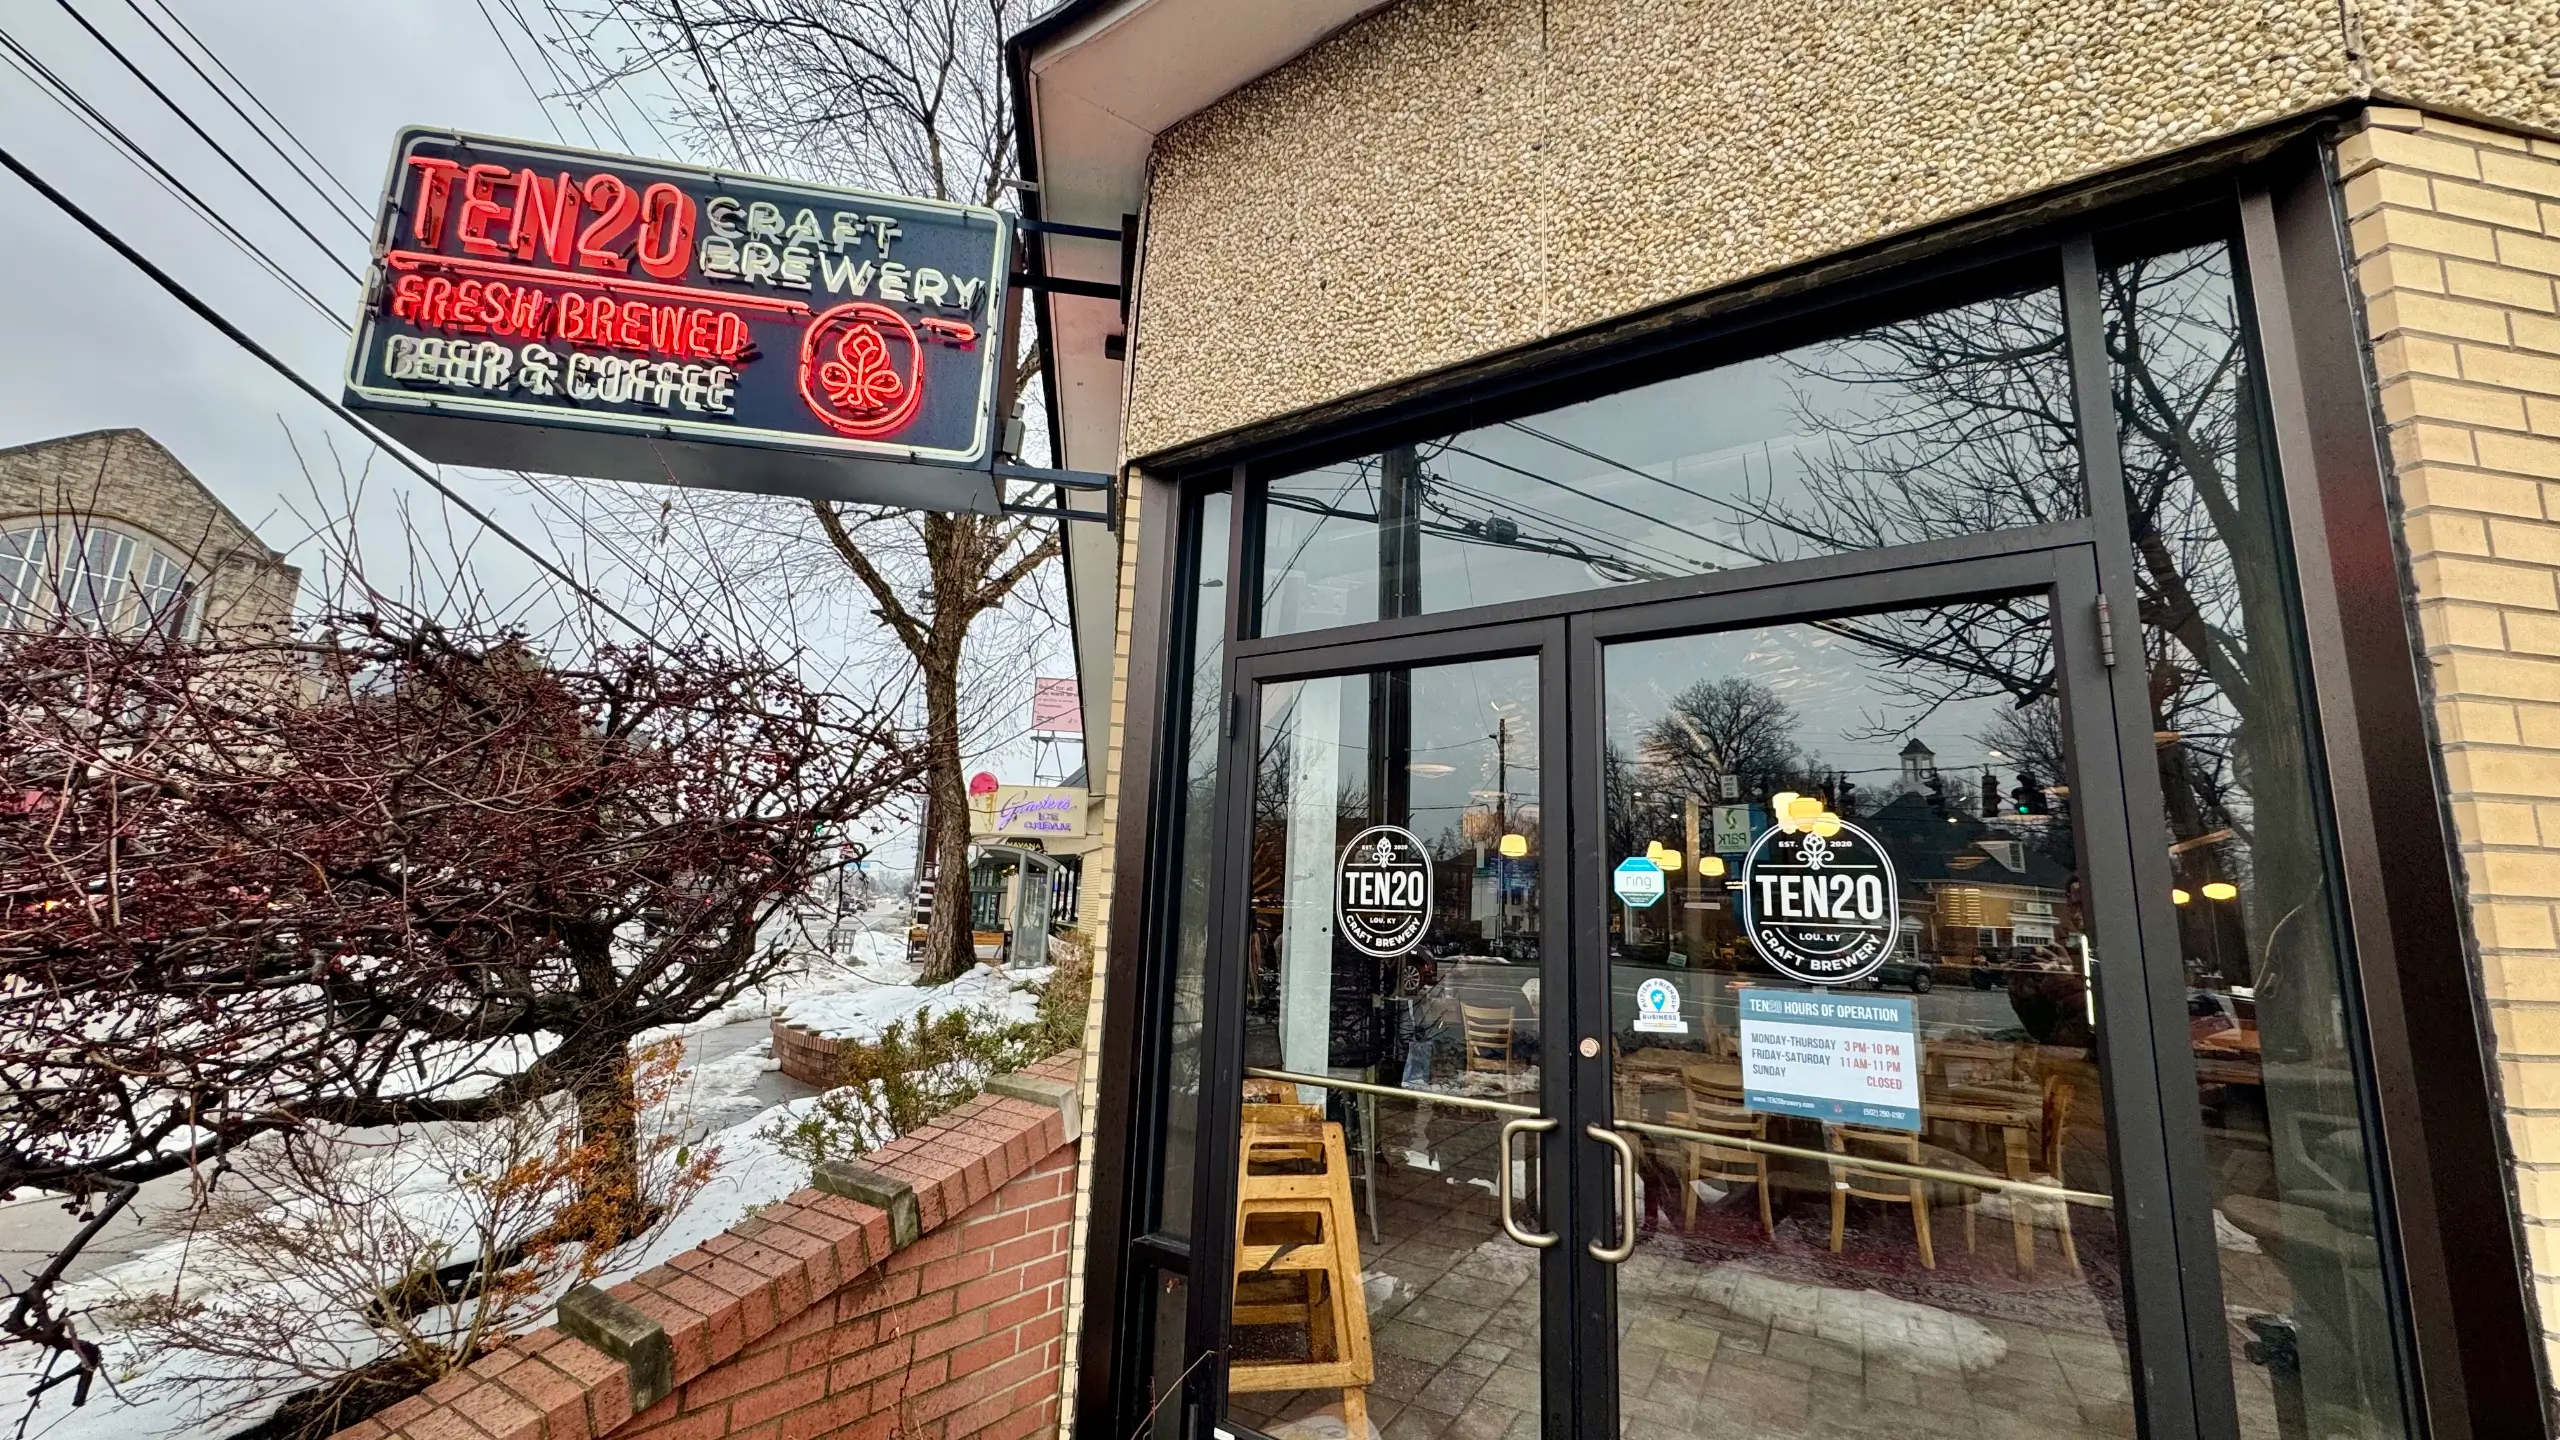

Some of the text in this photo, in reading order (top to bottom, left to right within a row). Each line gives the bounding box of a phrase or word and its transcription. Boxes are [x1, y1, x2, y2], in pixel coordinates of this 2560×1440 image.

[408, 156, 697, 279] TEN20
[707, 196, 903, 259] CRAFT
[700, 235, 986, 311] BREWERY
[393, 275, 752, 361] FRESH BREWED
[384, 334, 740, 415] BEER & COFFEE
[1345, 870, 1424, 907] TEN20
[1626, 873, 1652, 889] ring
[1755, 874, 1883, 920] TEN20
[1346, 915, 1421, 947] CRAFT BREWERY
[1799, 933, 1841, 942] LOU. KY
[1761, 929, 1881, 971] CRAFT BREWERY
[1640, 980, 1677, 1010] AUTISM FRIENDLY
[1749, 998, 1899, 1022] TEN20 HOURS OF OPERATION
[1751, 1032, 1837, 1051] MONDAY-THURSDAY
[1844, 1041, 1850, 1052] 3
[1885, 1044, 1900, 1056] PM
[1752, 1048, 1831, 1066] FRIDAY-SATURDAY
[1840, 1057, 1851, 1068] 11
[1887, 1061, 1901, 1073] PM
[1752, 1064, 1903, 1090] SUNDAY CLOSED
